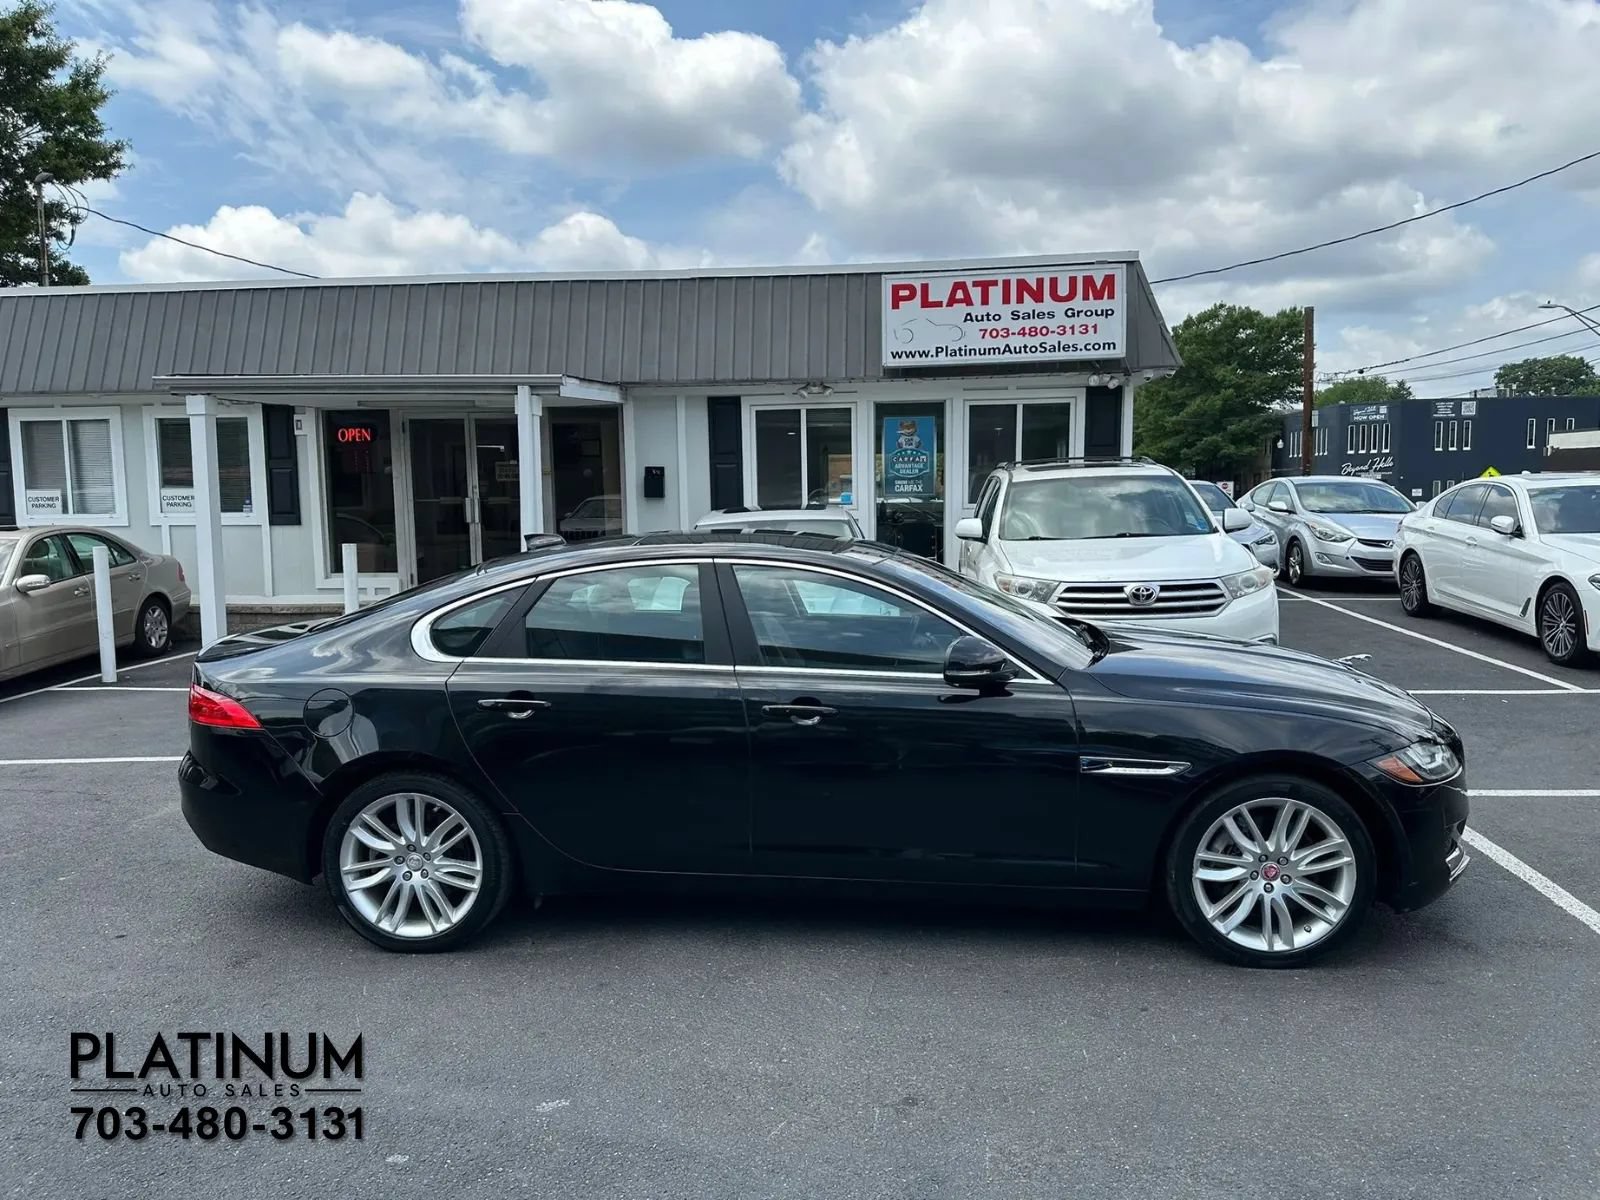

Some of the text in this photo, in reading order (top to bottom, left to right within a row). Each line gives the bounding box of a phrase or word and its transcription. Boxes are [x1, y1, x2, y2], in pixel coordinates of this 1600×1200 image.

[891, 273, 1115, 310] PLATINUM
[963, 307, 1115, 323] Auto Sales Group
[979, 323, 1099, 339] 703-480-3131
[890, 340, 1117, 360] www.PlatinumAutoSales.com
[338, 428, 371, 442] OPEN
[894, 484, 923, 492] CARFAX
